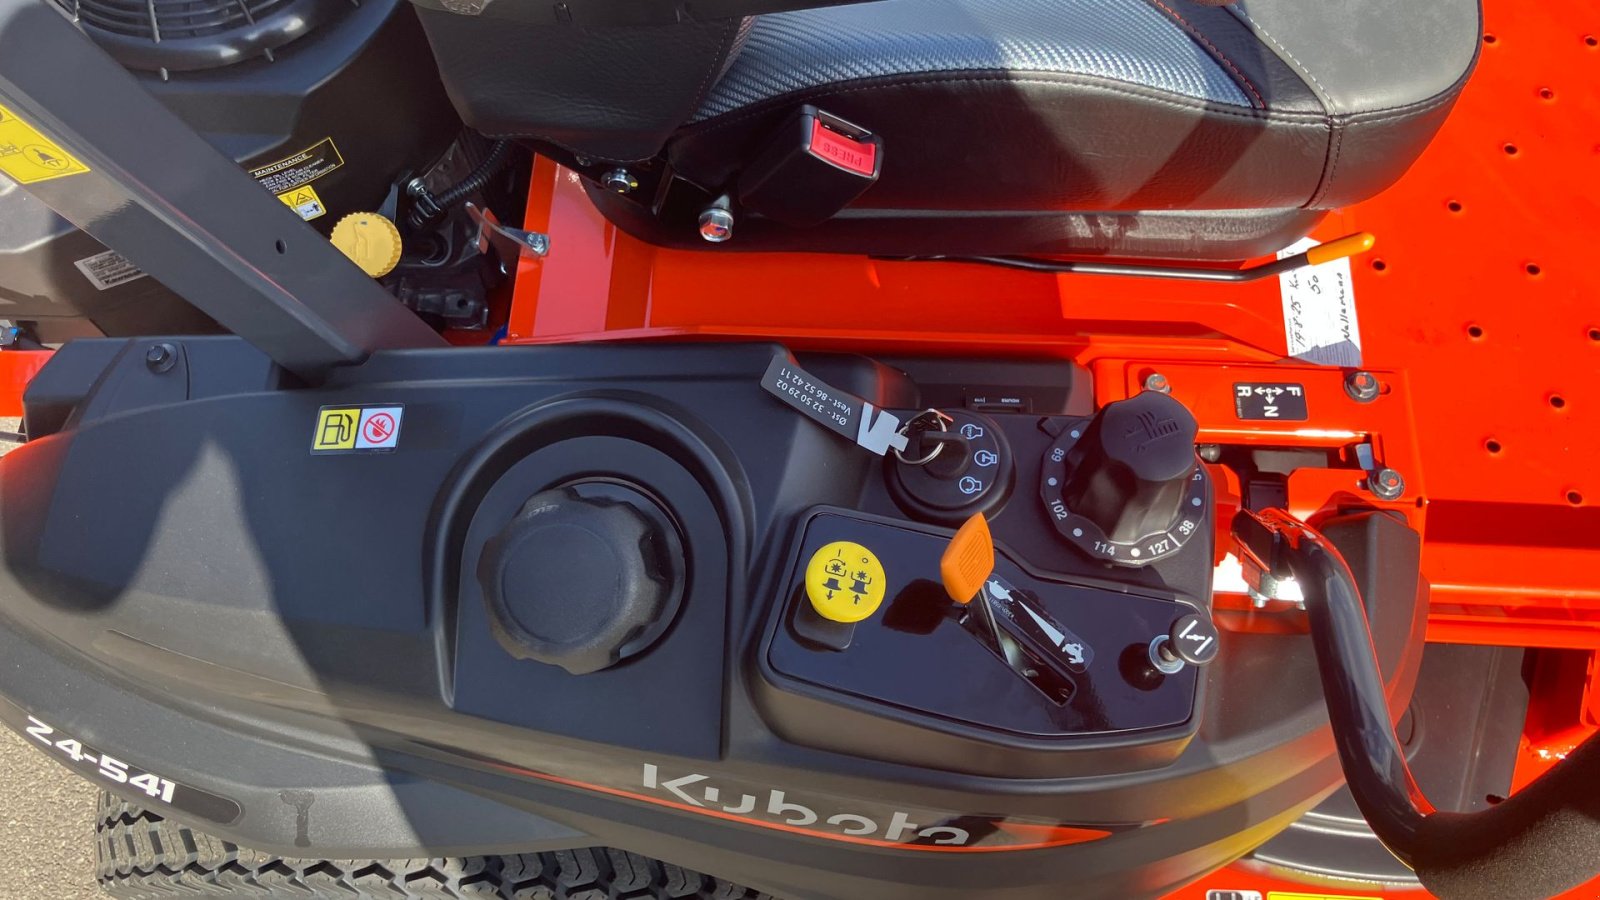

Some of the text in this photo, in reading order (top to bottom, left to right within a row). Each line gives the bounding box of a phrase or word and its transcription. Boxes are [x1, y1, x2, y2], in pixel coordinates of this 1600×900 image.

[823, 143, 862, 167] PRESS
[254, 153, 308, 176] MAINTENANCE
[780, 367, 791, 380] 11
[793, 374, 804, 387] 42
[776, 379, 788, 391] 02
[804, 381, 816, 394] 52
[1237, 386, 1252, 397] R
[1286, 386, 1301, 397] F
[788, 387, 800, 399] 29
[800, 394, 812, 406] 50
[817, 389, 828, 401] 86
[813, 401, 824, 413] 32
[833, 399, 852, 415] Vest
[1263, 406, 1279, 417] N
[832, 411, 847, 426] Øst
[1051, 447, 1065, 463] 89
[1050, 499, 1067, 520] 102
[1179, 520, 1195, 535] 38
[1094, 541, 1115, 556] 114
[1148, 540, 1170, 555] 127
[24, 715, 176, 804] Z4-541
[642, 763, 970, 846] Kubota
